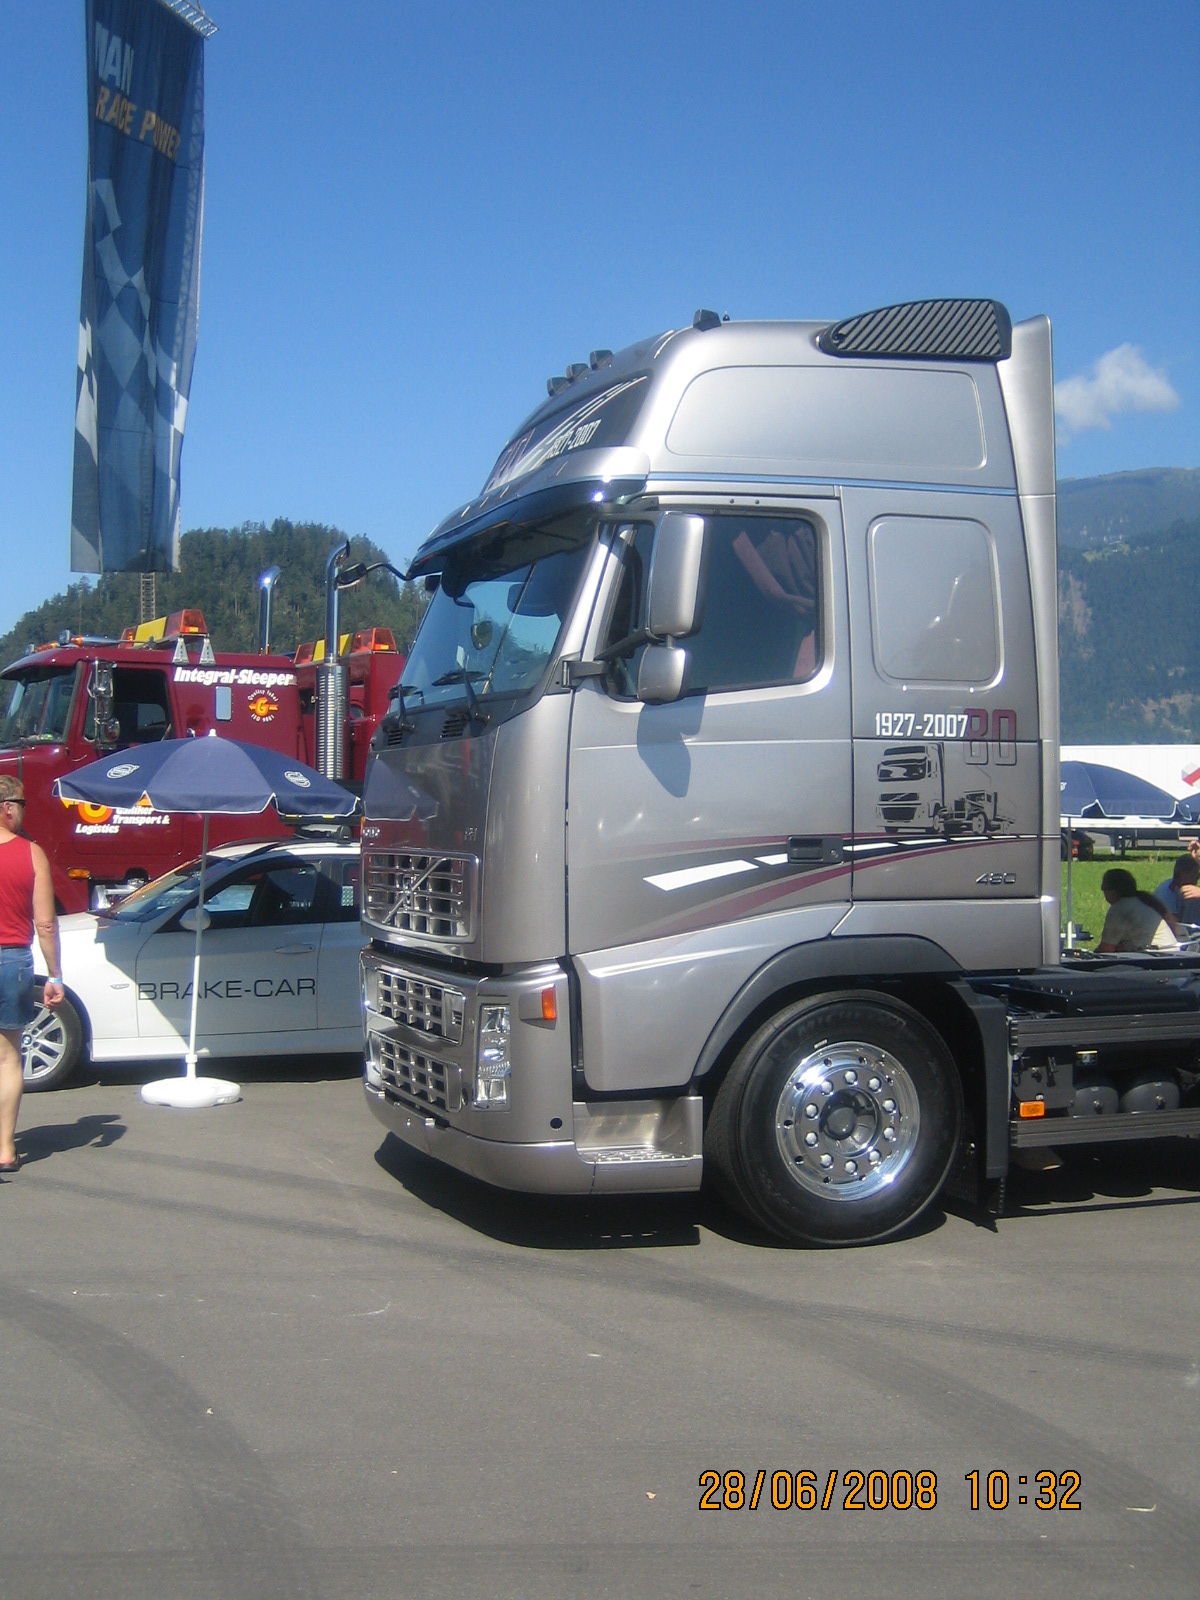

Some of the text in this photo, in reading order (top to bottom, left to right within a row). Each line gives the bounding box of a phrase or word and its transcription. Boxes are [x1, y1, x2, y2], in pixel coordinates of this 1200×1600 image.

[96, 85, 137, 135] RACE
[173, 666, 294, 688] Integral-Sleeper
[875, 712, 969, 738] 1927-2007
[963, 708, 1017, 766] 80
[75, 823, 120, 835] Logistics
[112, 815, 170, 826] Transport &
[138, 978, 316, 1001] BRAKE-CAR
